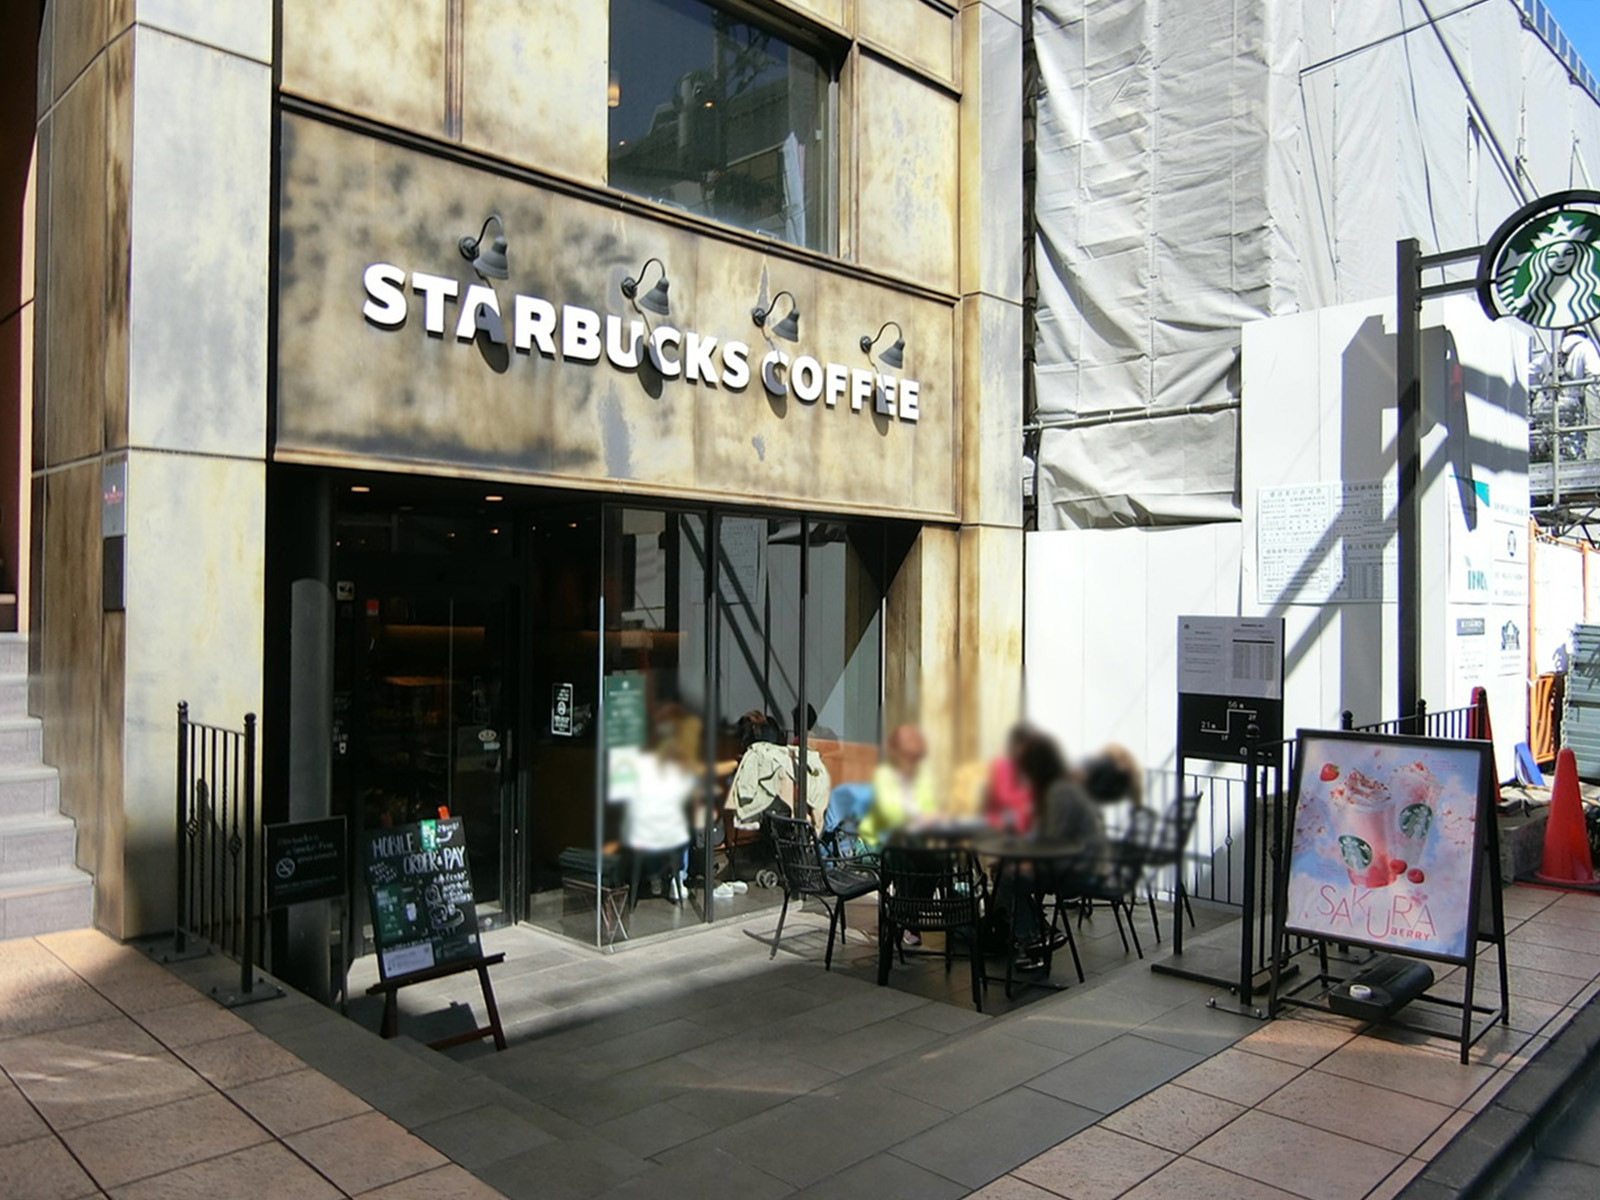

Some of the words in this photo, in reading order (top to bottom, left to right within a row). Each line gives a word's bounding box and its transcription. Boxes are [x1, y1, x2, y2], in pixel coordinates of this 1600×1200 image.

[362, 263, 750, 391] STARBUCKS
[760, 350, 920, 421] COFFEE
[372, 832, 414, 858] MOBILE
[403, 850, 440, 875] ORDER
[443, 845, 465, 870] PAY
[1316, 884, 1436, 938] SAKURA
[1390, 927, 1430, 941] BERRY
